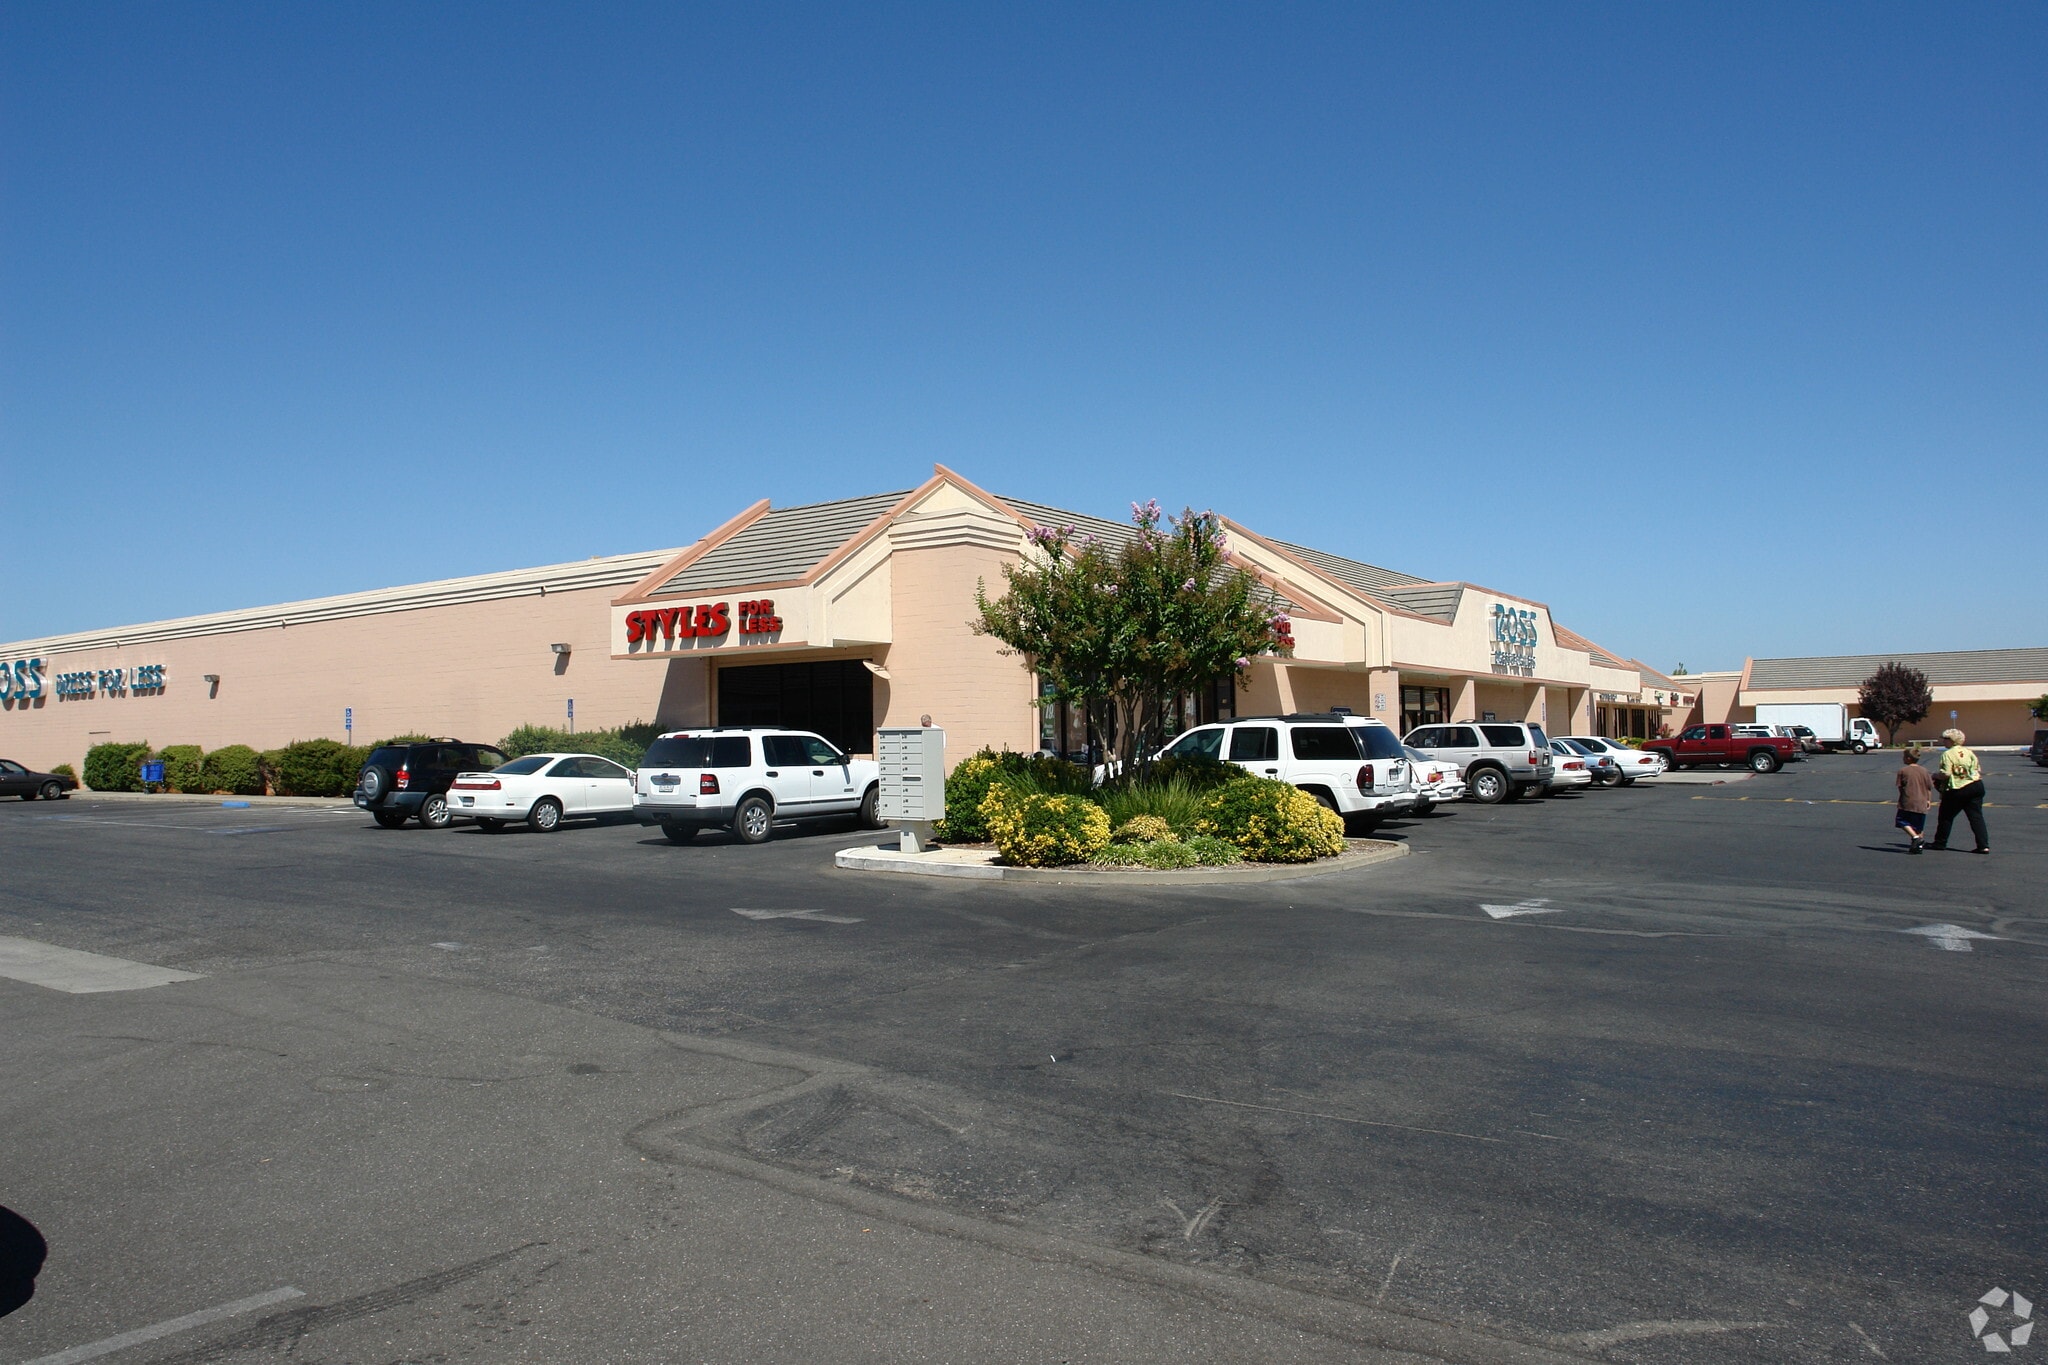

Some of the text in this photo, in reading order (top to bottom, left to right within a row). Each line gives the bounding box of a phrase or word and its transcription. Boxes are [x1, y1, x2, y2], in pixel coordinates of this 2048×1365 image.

[739, 599, 772, 616] FOR
[625, 602, 730, 643] STYLES
[739, 616, 781, 634] LESS
[1494, 603, 1537, 648] ROSS
[98, 668, 127, 692] FOR
[130, 664, 167, 690] LESS
